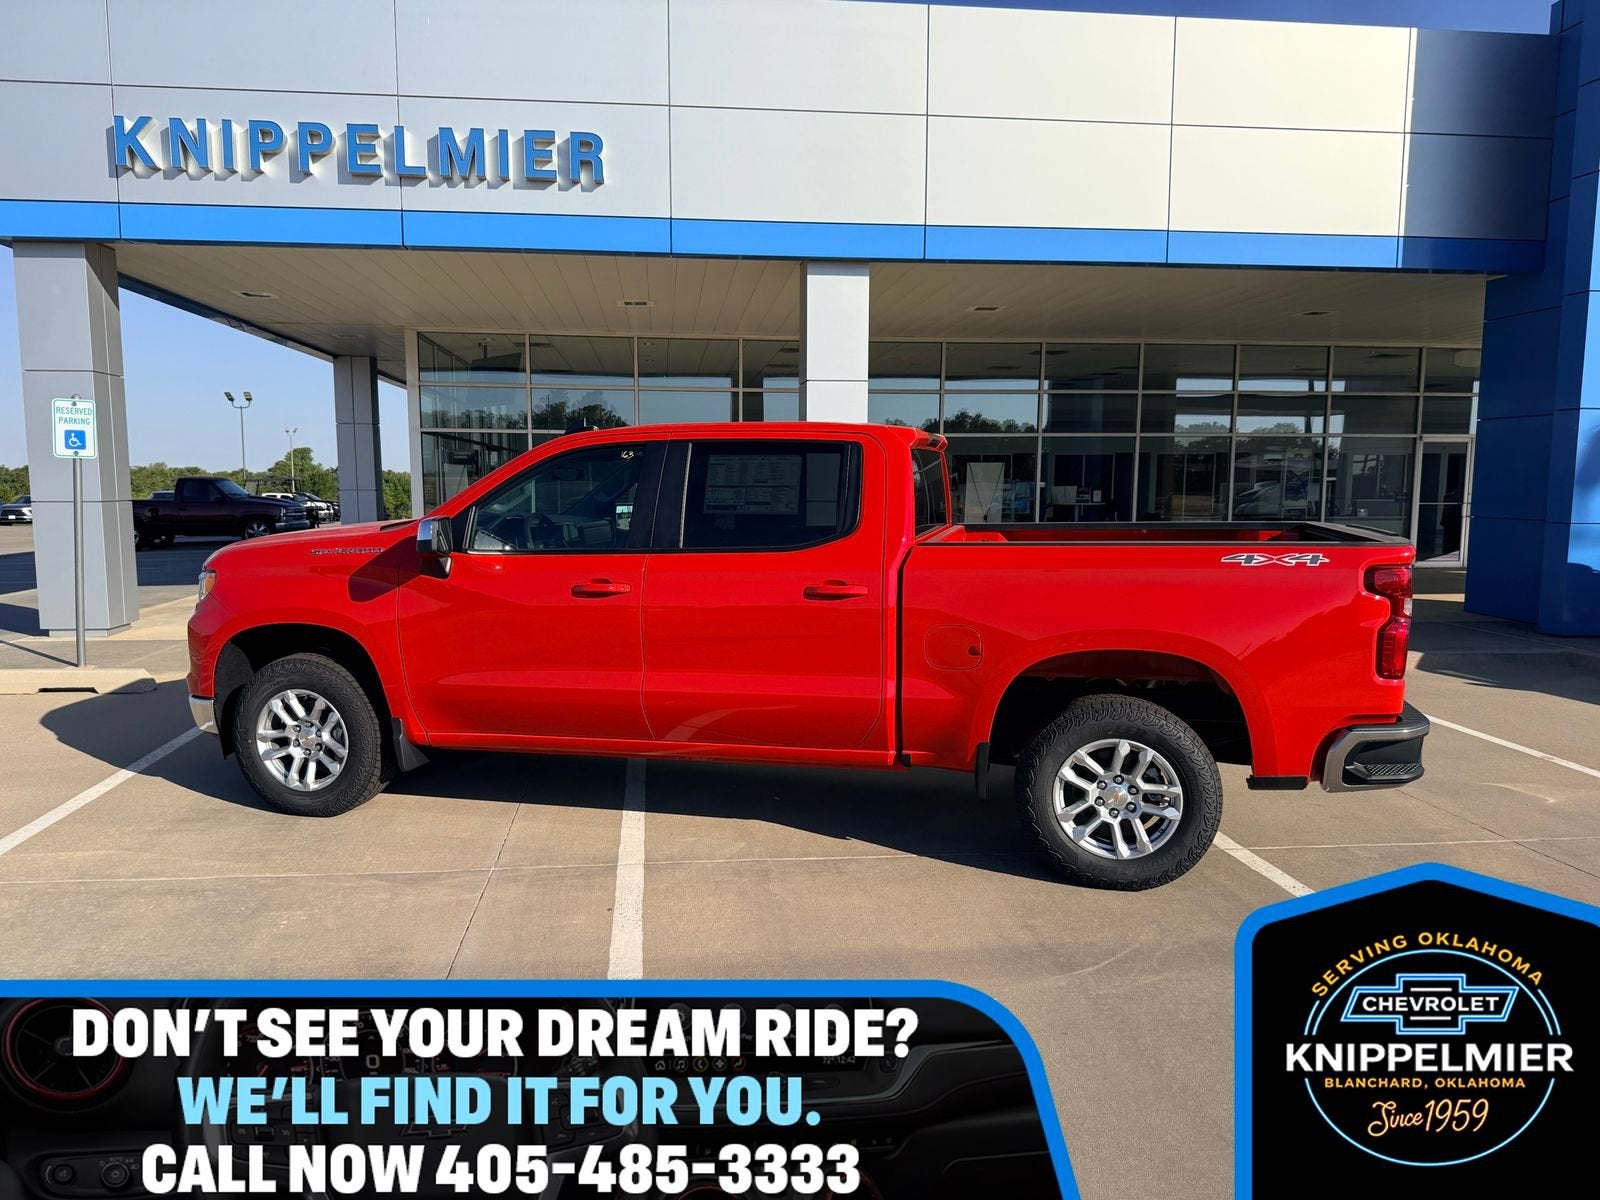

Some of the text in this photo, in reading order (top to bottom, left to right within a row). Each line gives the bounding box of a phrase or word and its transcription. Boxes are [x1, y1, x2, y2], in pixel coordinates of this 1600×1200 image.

[113, 115, 605, 185] KNIPPELMIER
[56, 407, 92, 416] RESERVED
[59, 417, 91, 425] PARKING
